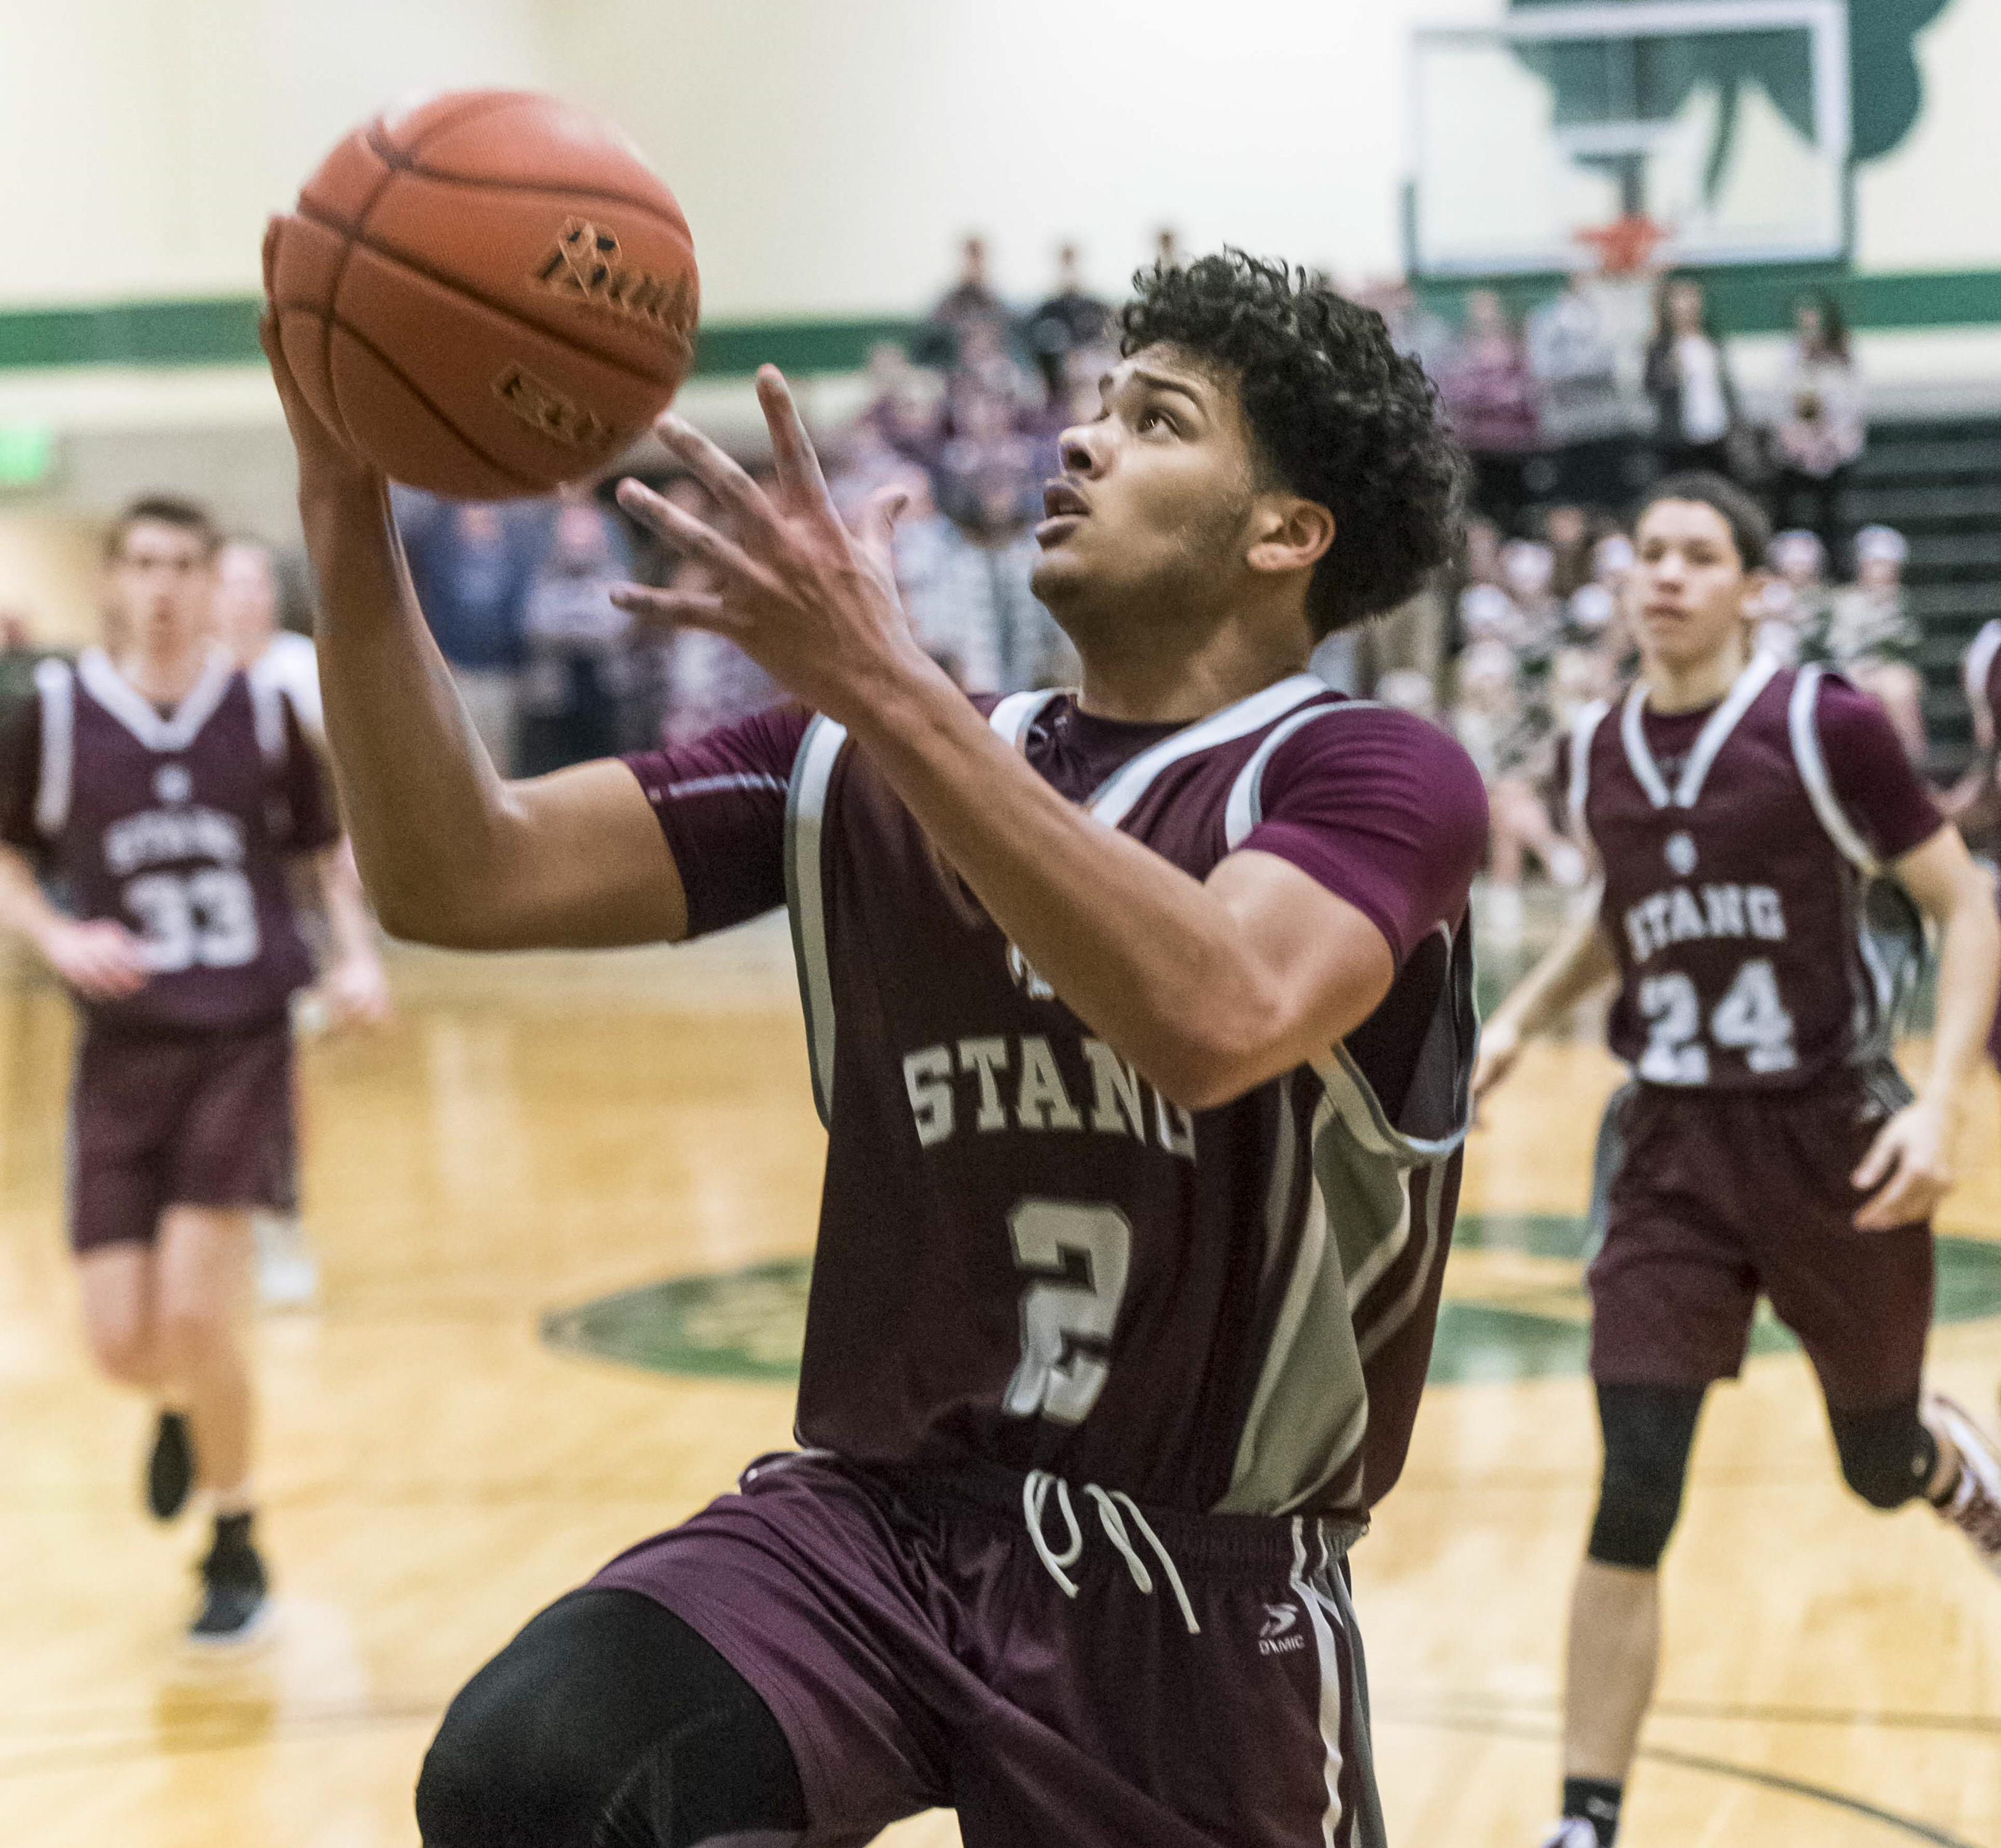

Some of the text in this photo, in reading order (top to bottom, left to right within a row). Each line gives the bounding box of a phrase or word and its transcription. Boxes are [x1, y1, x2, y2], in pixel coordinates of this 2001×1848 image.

[123, 870, 260, 973] 33
[1636, 957, 1799, 1087] 24
[1003, 1195, 1133, 1427] 2
